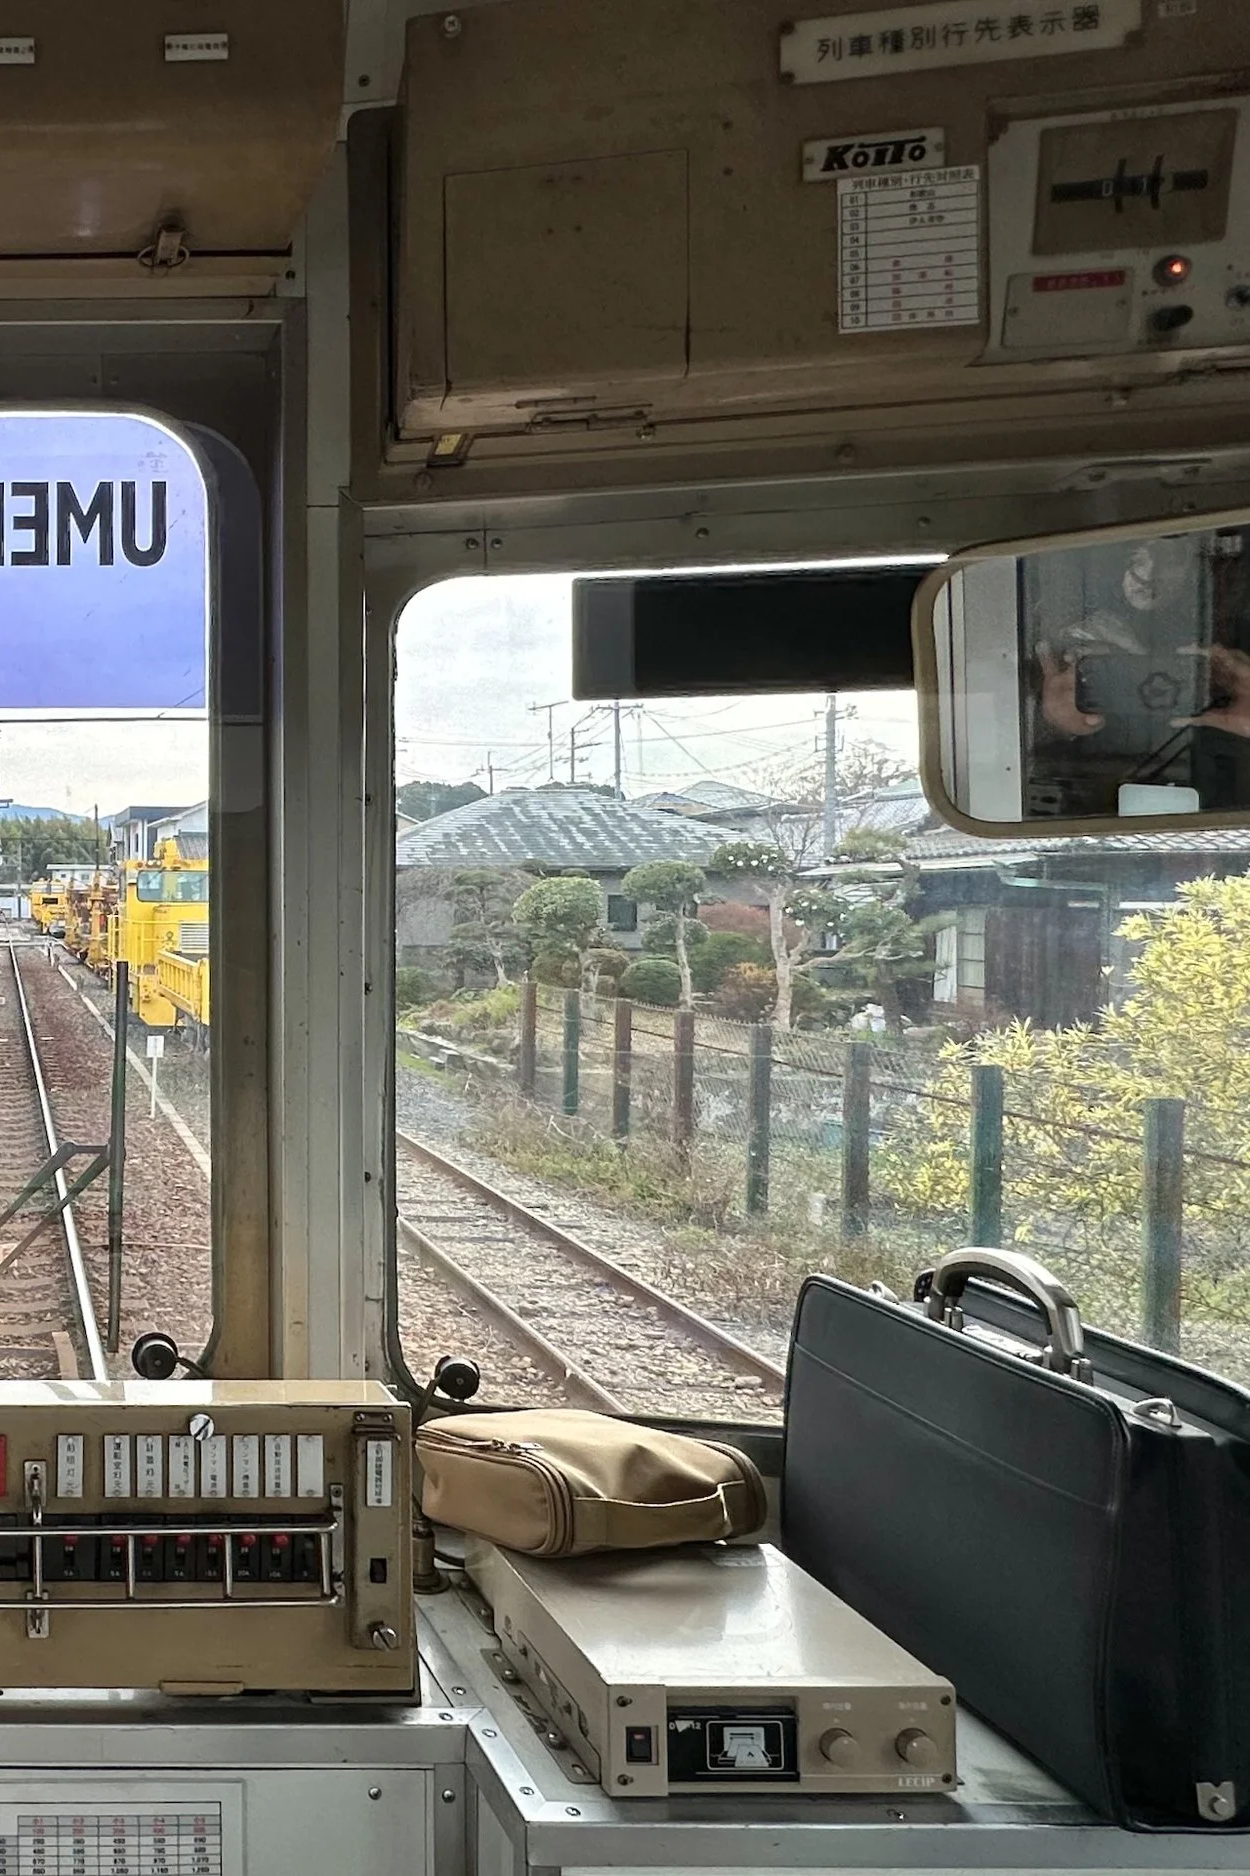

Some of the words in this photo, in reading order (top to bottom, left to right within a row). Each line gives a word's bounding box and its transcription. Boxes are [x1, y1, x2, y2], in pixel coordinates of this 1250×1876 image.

[817, 5, 1100, 63] 列車種別行先表示器
[897, 1777, 934, 1787] LECIP
